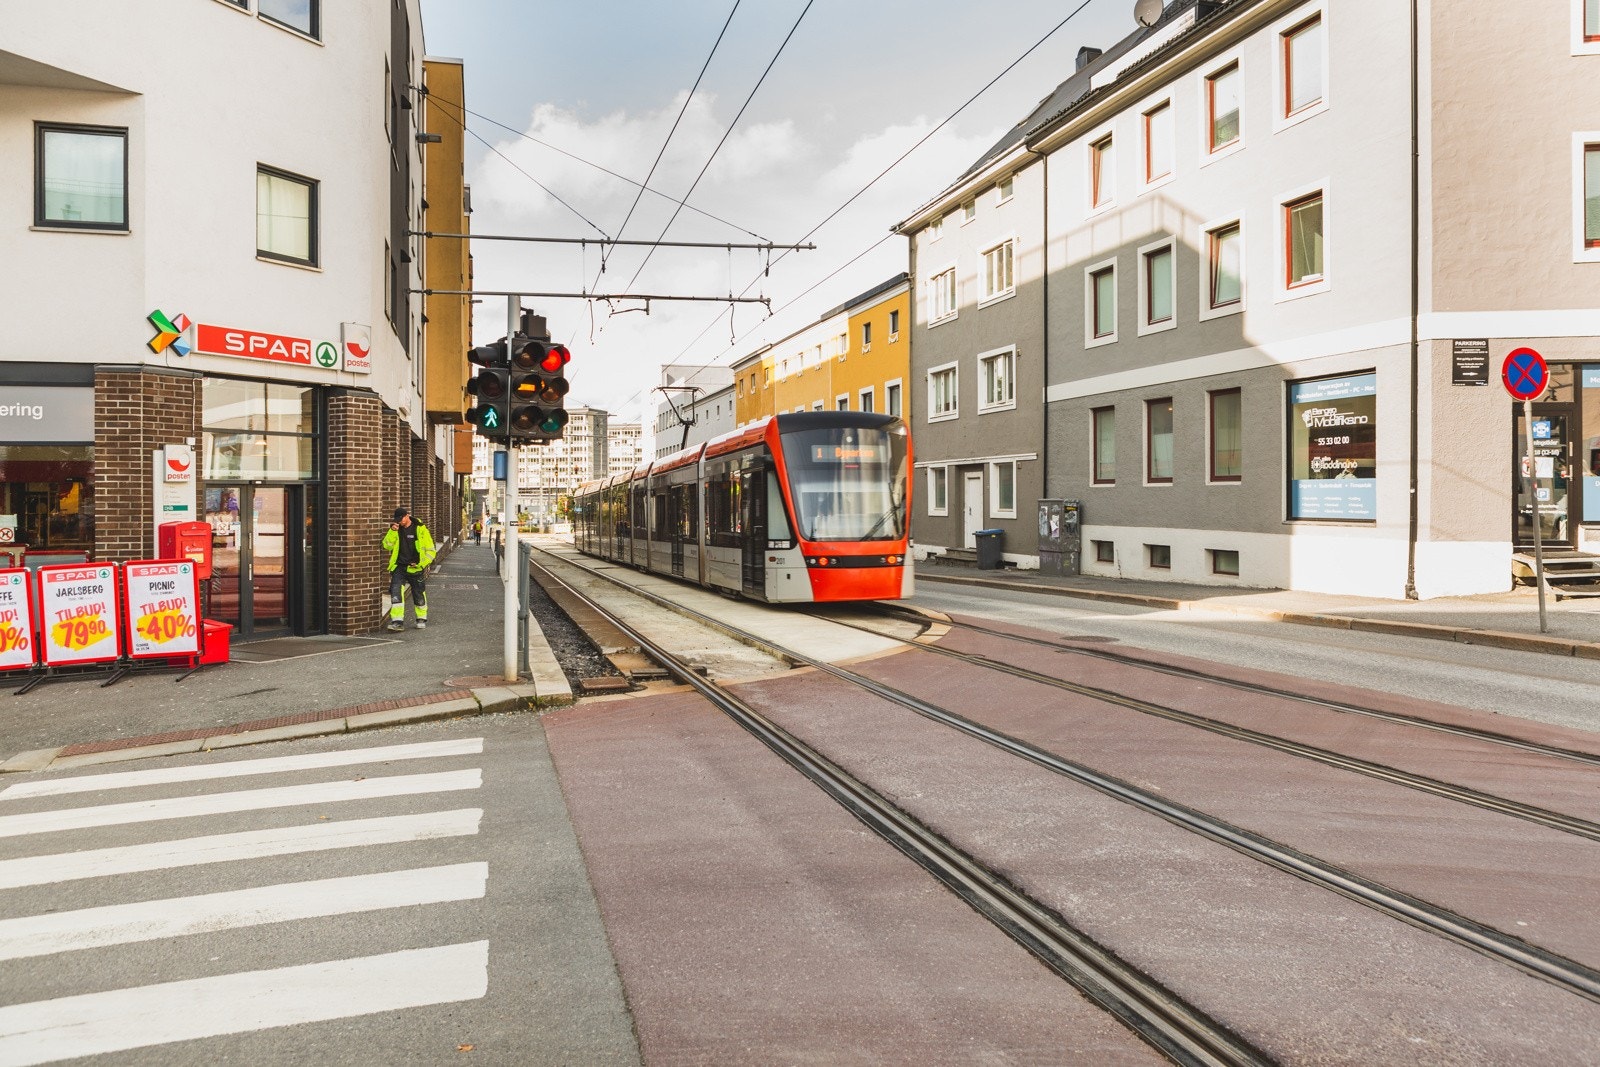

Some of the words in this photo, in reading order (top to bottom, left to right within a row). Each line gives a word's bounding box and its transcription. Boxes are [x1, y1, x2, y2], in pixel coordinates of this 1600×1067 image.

[225, 332, 310, 361] SPAR
[346, 359, 371, 368] posten
[817, 447, 822, 458] 1
[55, 571, 96, 581] SPAR
[140, 566, 178, 576] SPAR
[56, 584, 104, 598] JARLSBERG
[149, 580, 175, 591] PICNIC
[55, 602, 107, 622] TILBUD!
[140, 597, 187, 615] TILBUD!
[136, 614, 195, 641] -40%
